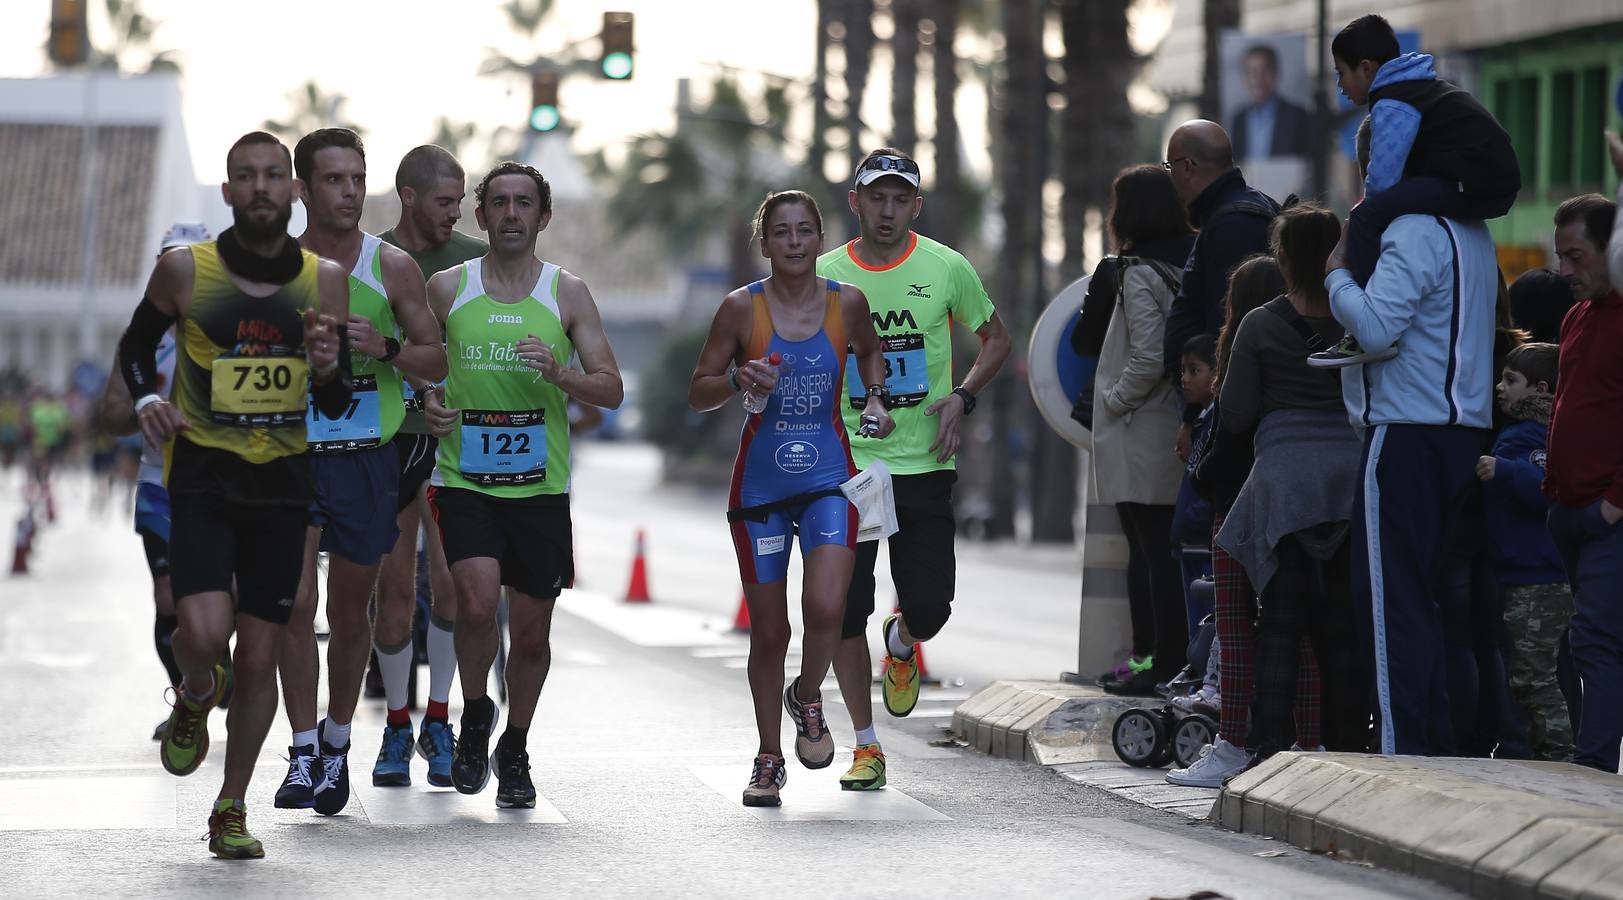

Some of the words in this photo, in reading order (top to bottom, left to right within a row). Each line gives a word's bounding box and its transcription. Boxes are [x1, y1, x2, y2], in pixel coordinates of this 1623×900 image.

[460, 341, 483, 360] Las
[233, 366, 292, 392] 730
[800, 373, 832, 396] SIERRA
[310, 399, 361, 422] 17
[780, 395, 822, 416] ESP
[481, 432, 530, 454] 122
[760, 538, 784, 546] Popular
